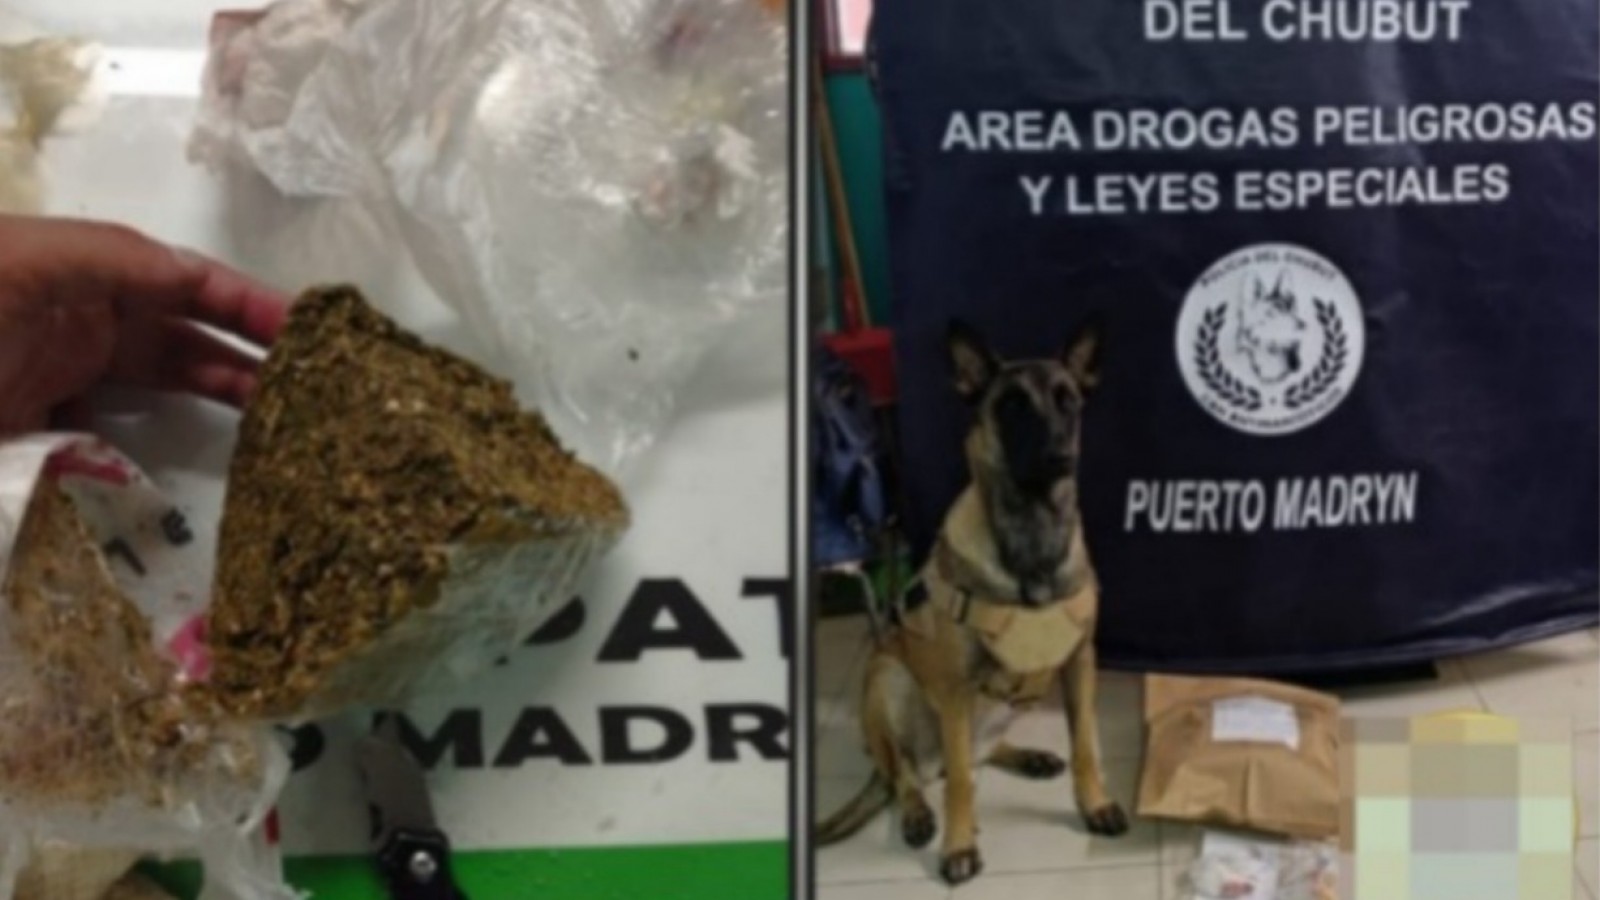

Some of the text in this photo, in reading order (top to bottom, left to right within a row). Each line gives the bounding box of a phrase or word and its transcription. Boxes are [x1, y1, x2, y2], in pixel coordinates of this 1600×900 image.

[1143, 0, 1471, 42] DEL CHUBUT
[941, 101, 1596, 151] AREA DROGAS PELIGROSAS
[1020, 164, 1511, 215] Y LEYES ESPECIALES
[1123, 471, 1419, 532] PUERTO MADRYN
